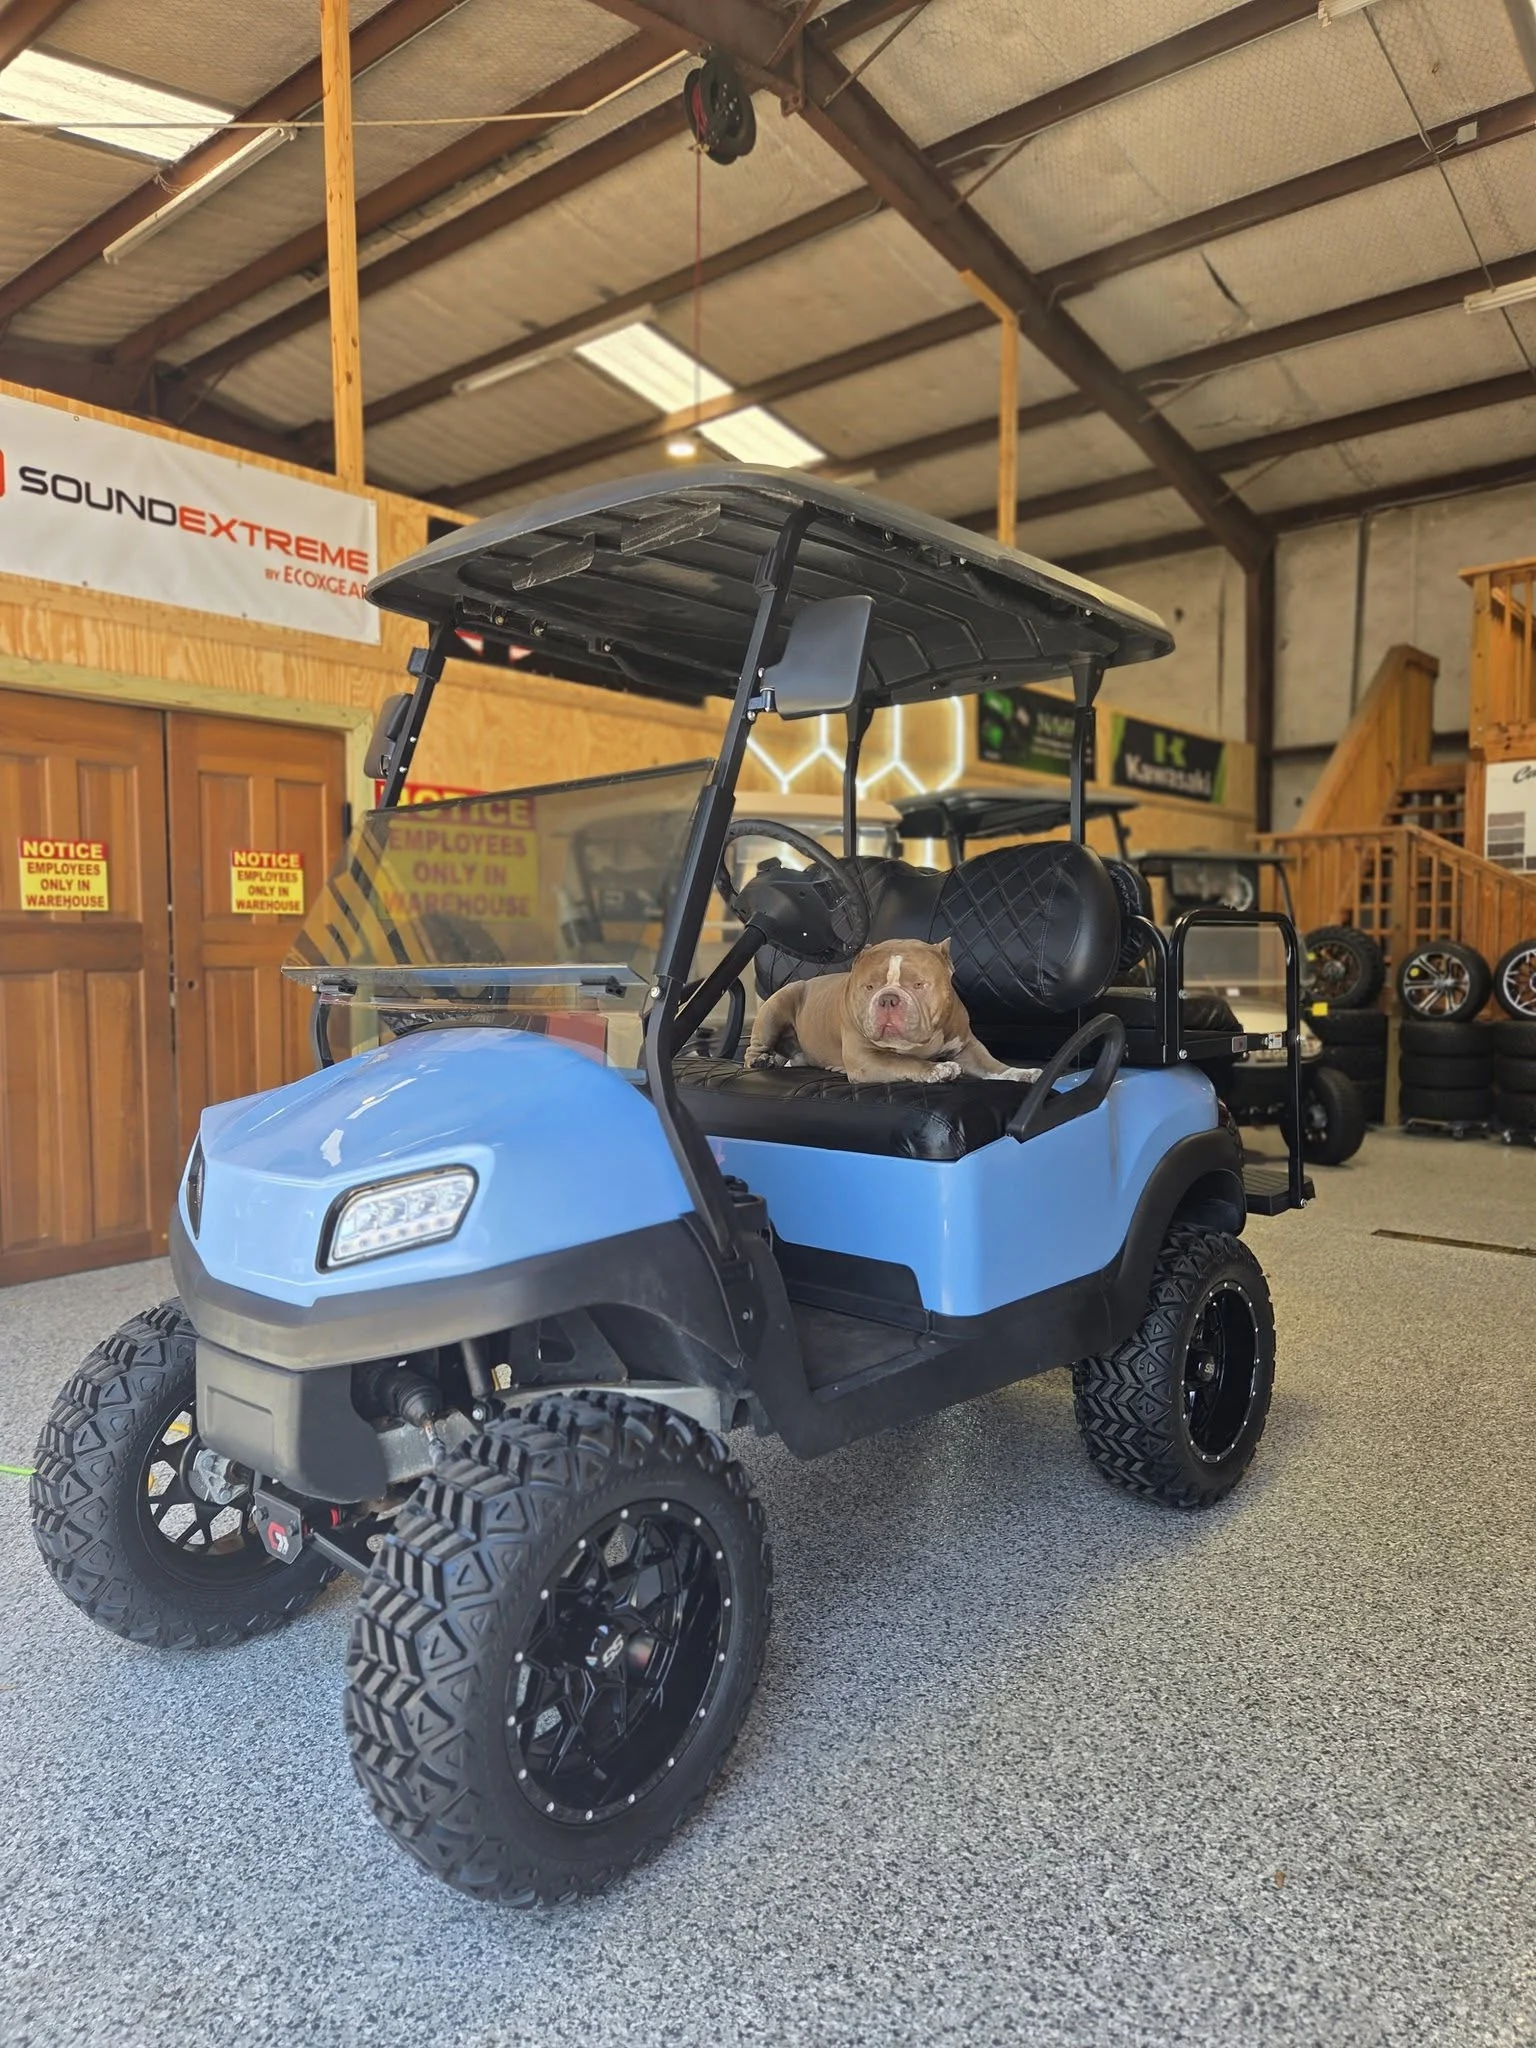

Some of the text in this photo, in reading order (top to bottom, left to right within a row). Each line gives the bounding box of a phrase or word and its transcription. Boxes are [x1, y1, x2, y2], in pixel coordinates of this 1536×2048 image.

[18, 465, 369, 575] SOUNDEXTREME
[264, 568, 280, 581] BY
[1125, 753, 1212, 796] Kawasaki
[23, 841, 104, 859] NOTICE
[388, 827, 527, 858] EMPLOYEES
[234, 851, 301, 868] NOTICE
[27, 862, 101, 876] EMPLOYEES
[237, 870, 298, 883] EMPLOYEES
[412, 860, 507, 886] ONLY IN
[40, 878, 90, 891] ONLY IN
[248, 885, 290, 897] ONLY IN
[26, 895, 105, 908] WAREHOUSE
[236, 899, 301, 911] WAREHOUSE
[384, 890, 530, 917] WAREHOUSE
